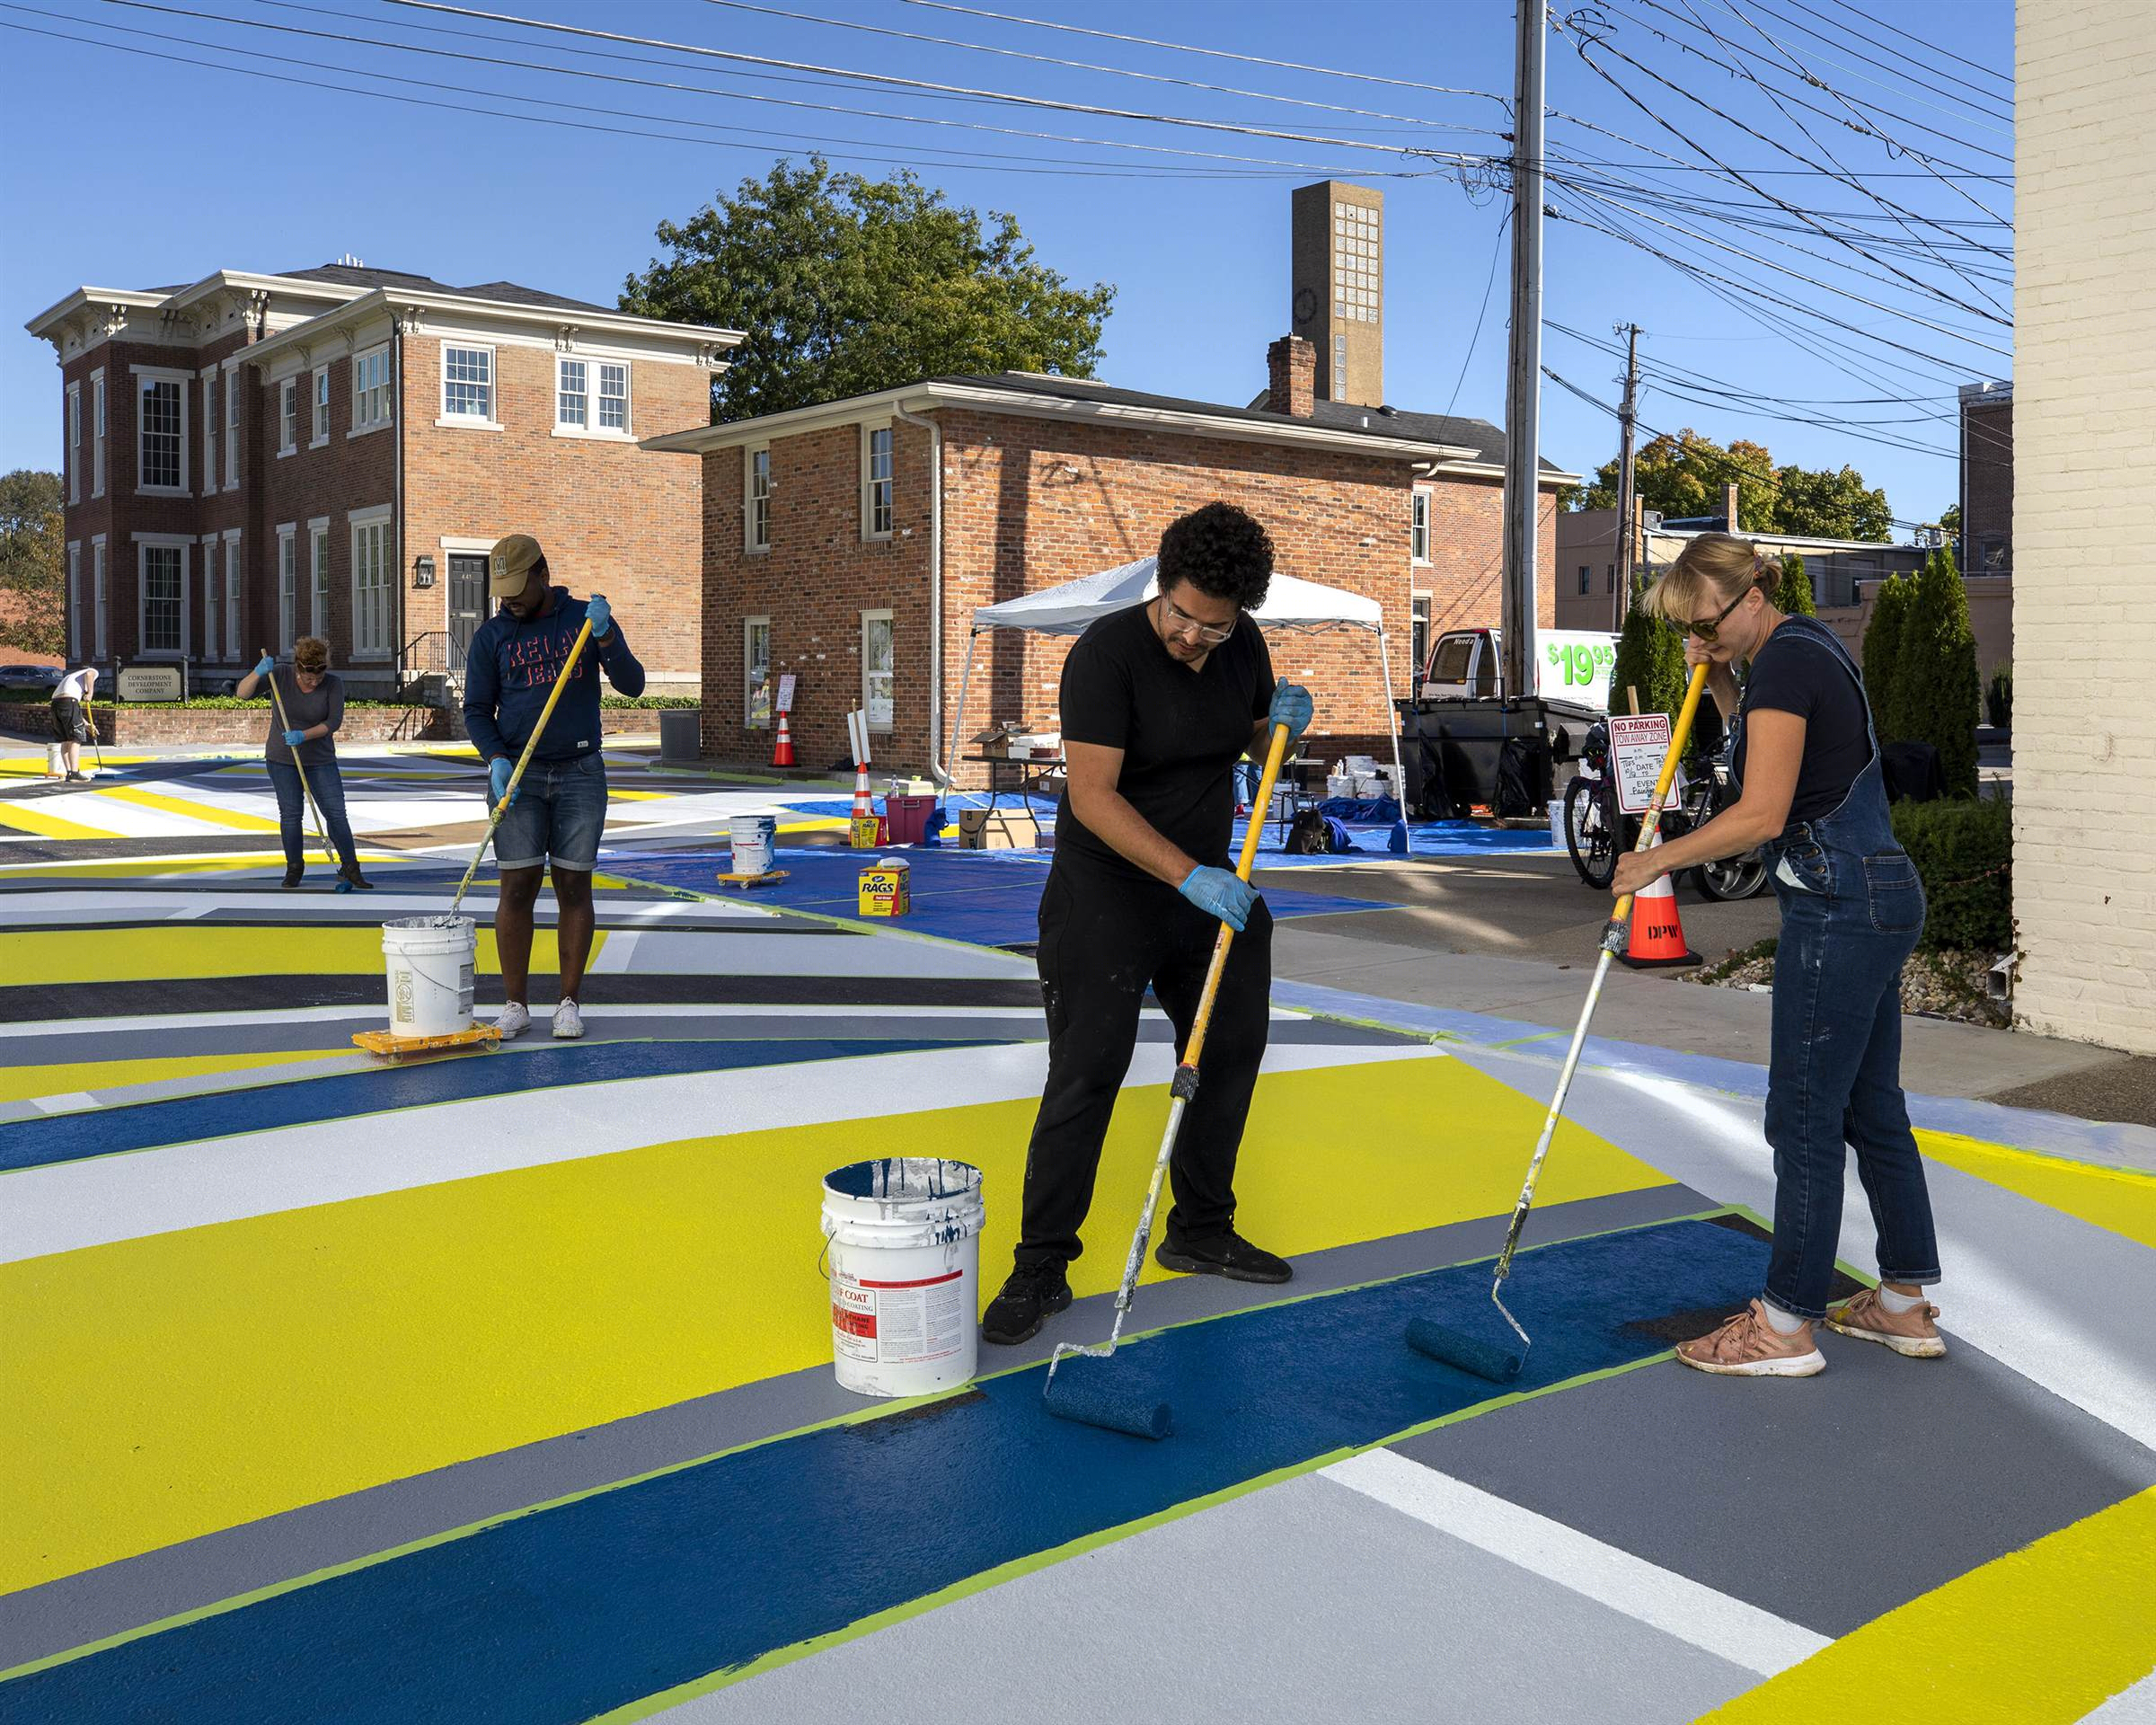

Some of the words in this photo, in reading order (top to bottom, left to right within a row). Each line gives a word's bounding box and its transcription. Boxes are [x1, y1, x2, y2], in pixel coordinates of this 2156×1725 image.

[506, 627, 588, 668] RELA
[525, 657, 583, 687] JEAS
[1614, 722, 1626, 731] NO
[1629, 720, 1666, 731] PARKING
[1615, 733, 1630, 744] TOW
[1630, 732, 1648, 743] AWAY
[1649, 731, 1667, 741] ZONE
[862, 883, 894, 892] RAGS
[1648, 925, 1677, 940] DPW
[845, 1290, 869, 1303] COAT
[846, 1301, 873, 1312] COATING
